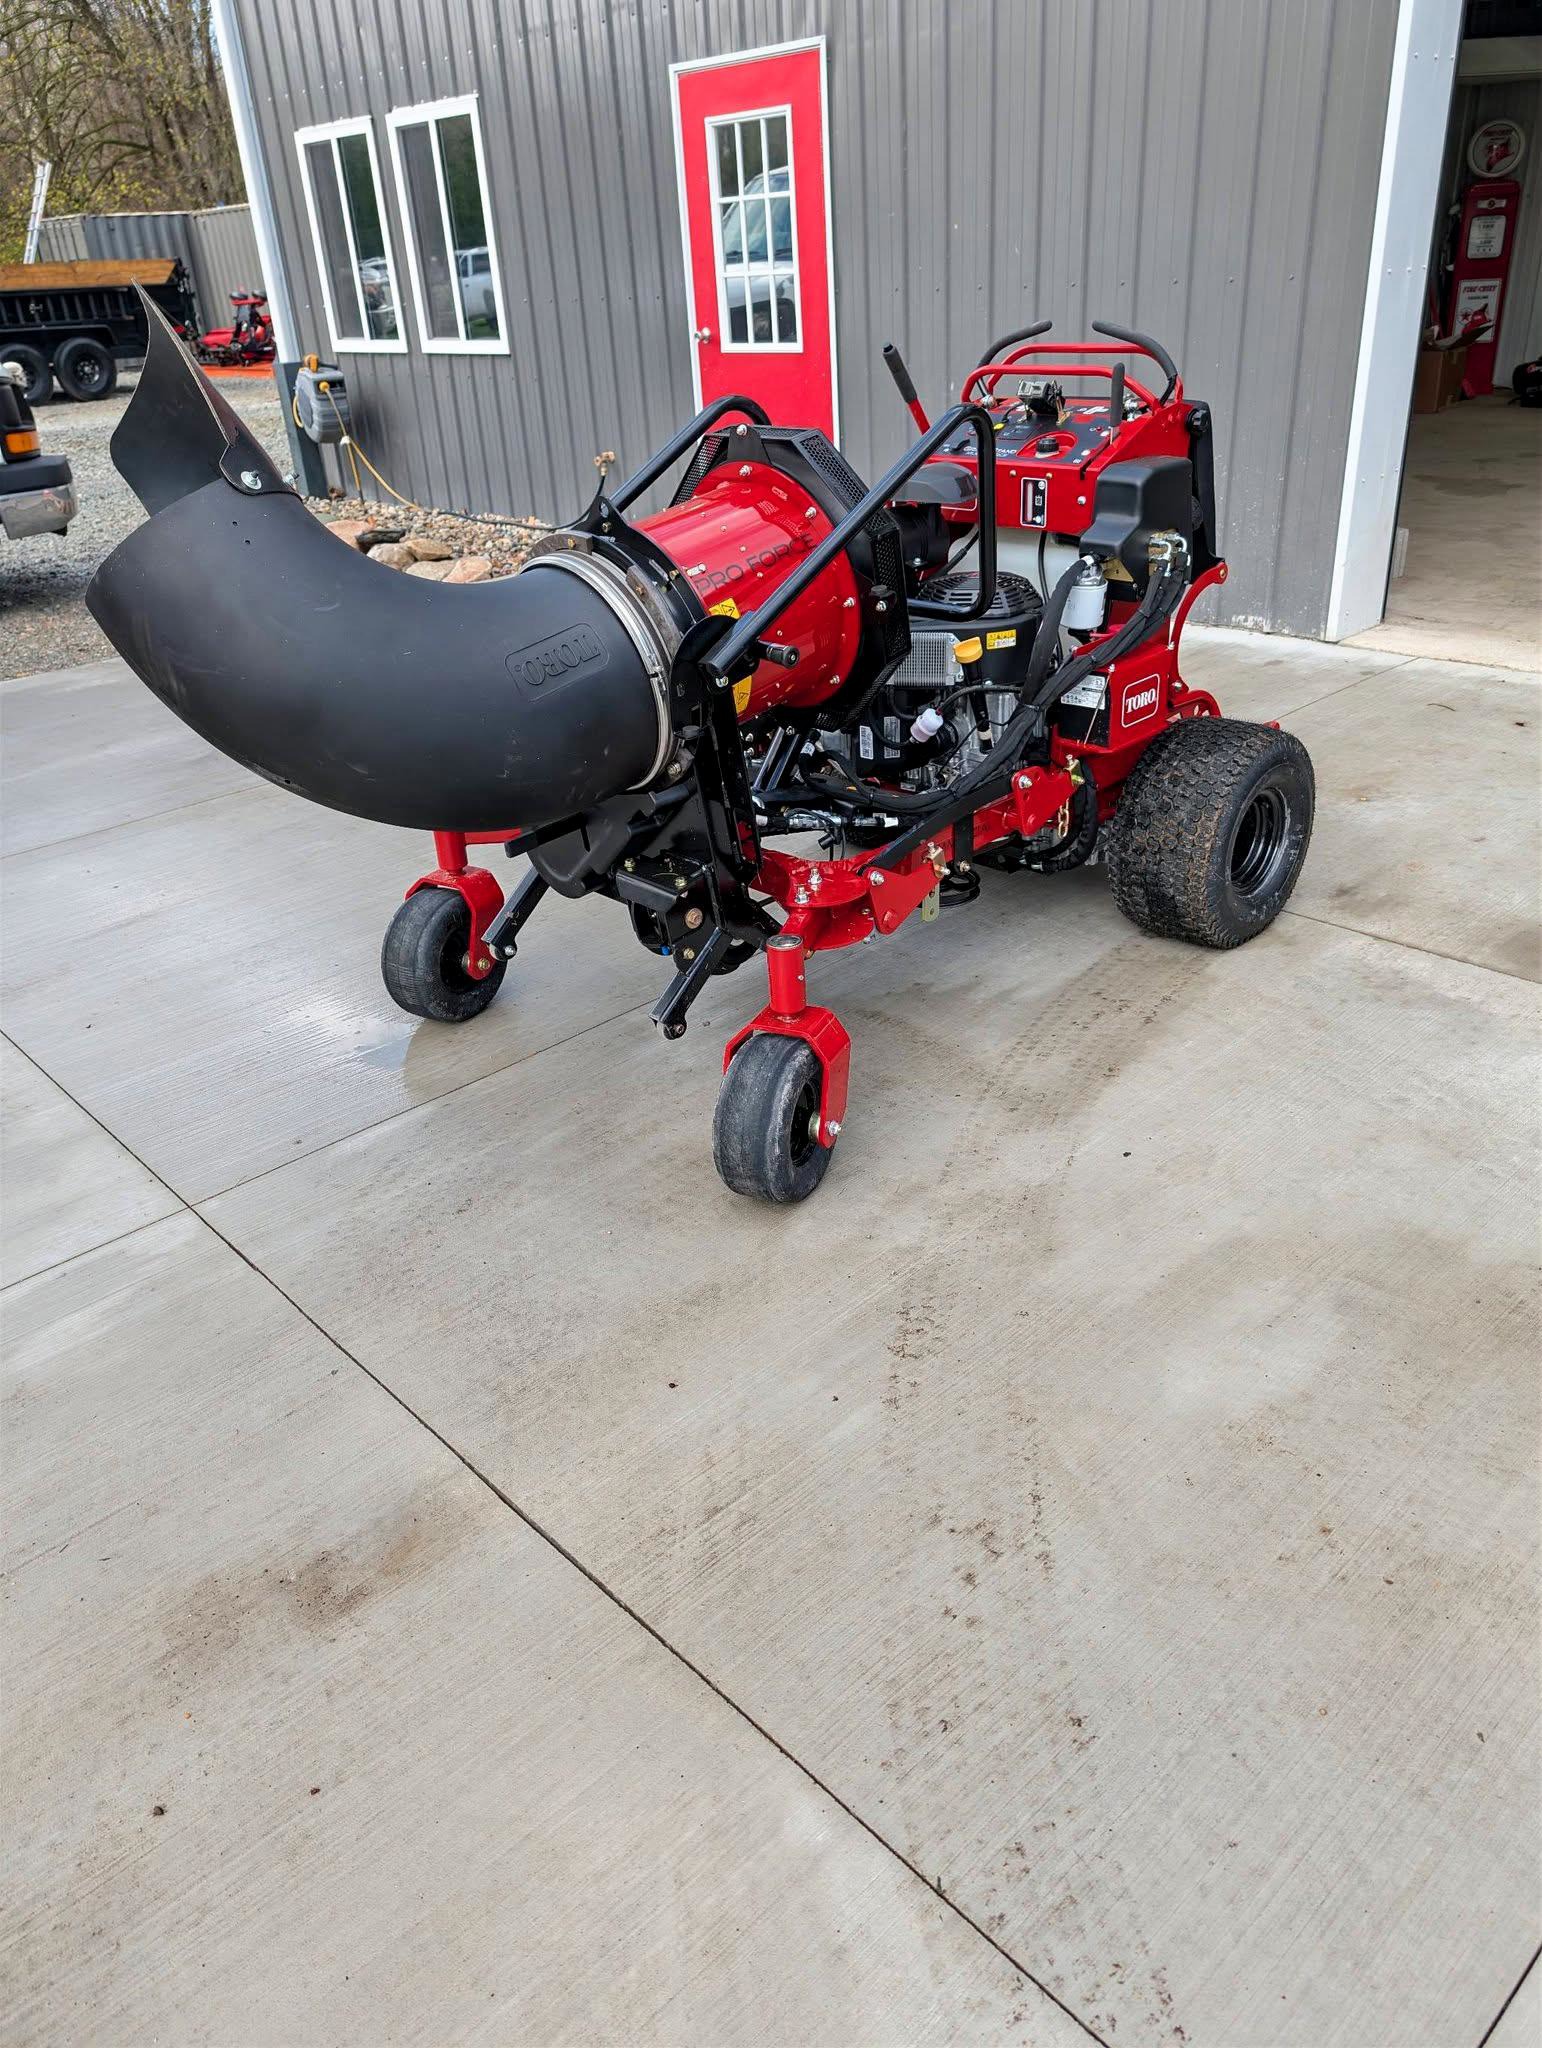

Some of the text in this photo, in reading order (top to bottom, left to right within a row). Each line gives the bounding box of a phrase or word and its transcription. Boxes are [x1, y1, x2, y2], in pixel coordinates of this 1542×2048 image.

[695, 533, 817, 597] PRO FORCE
[520, 634, 601, 686] TORO
[1126, 688, 1157, 713] TORO
